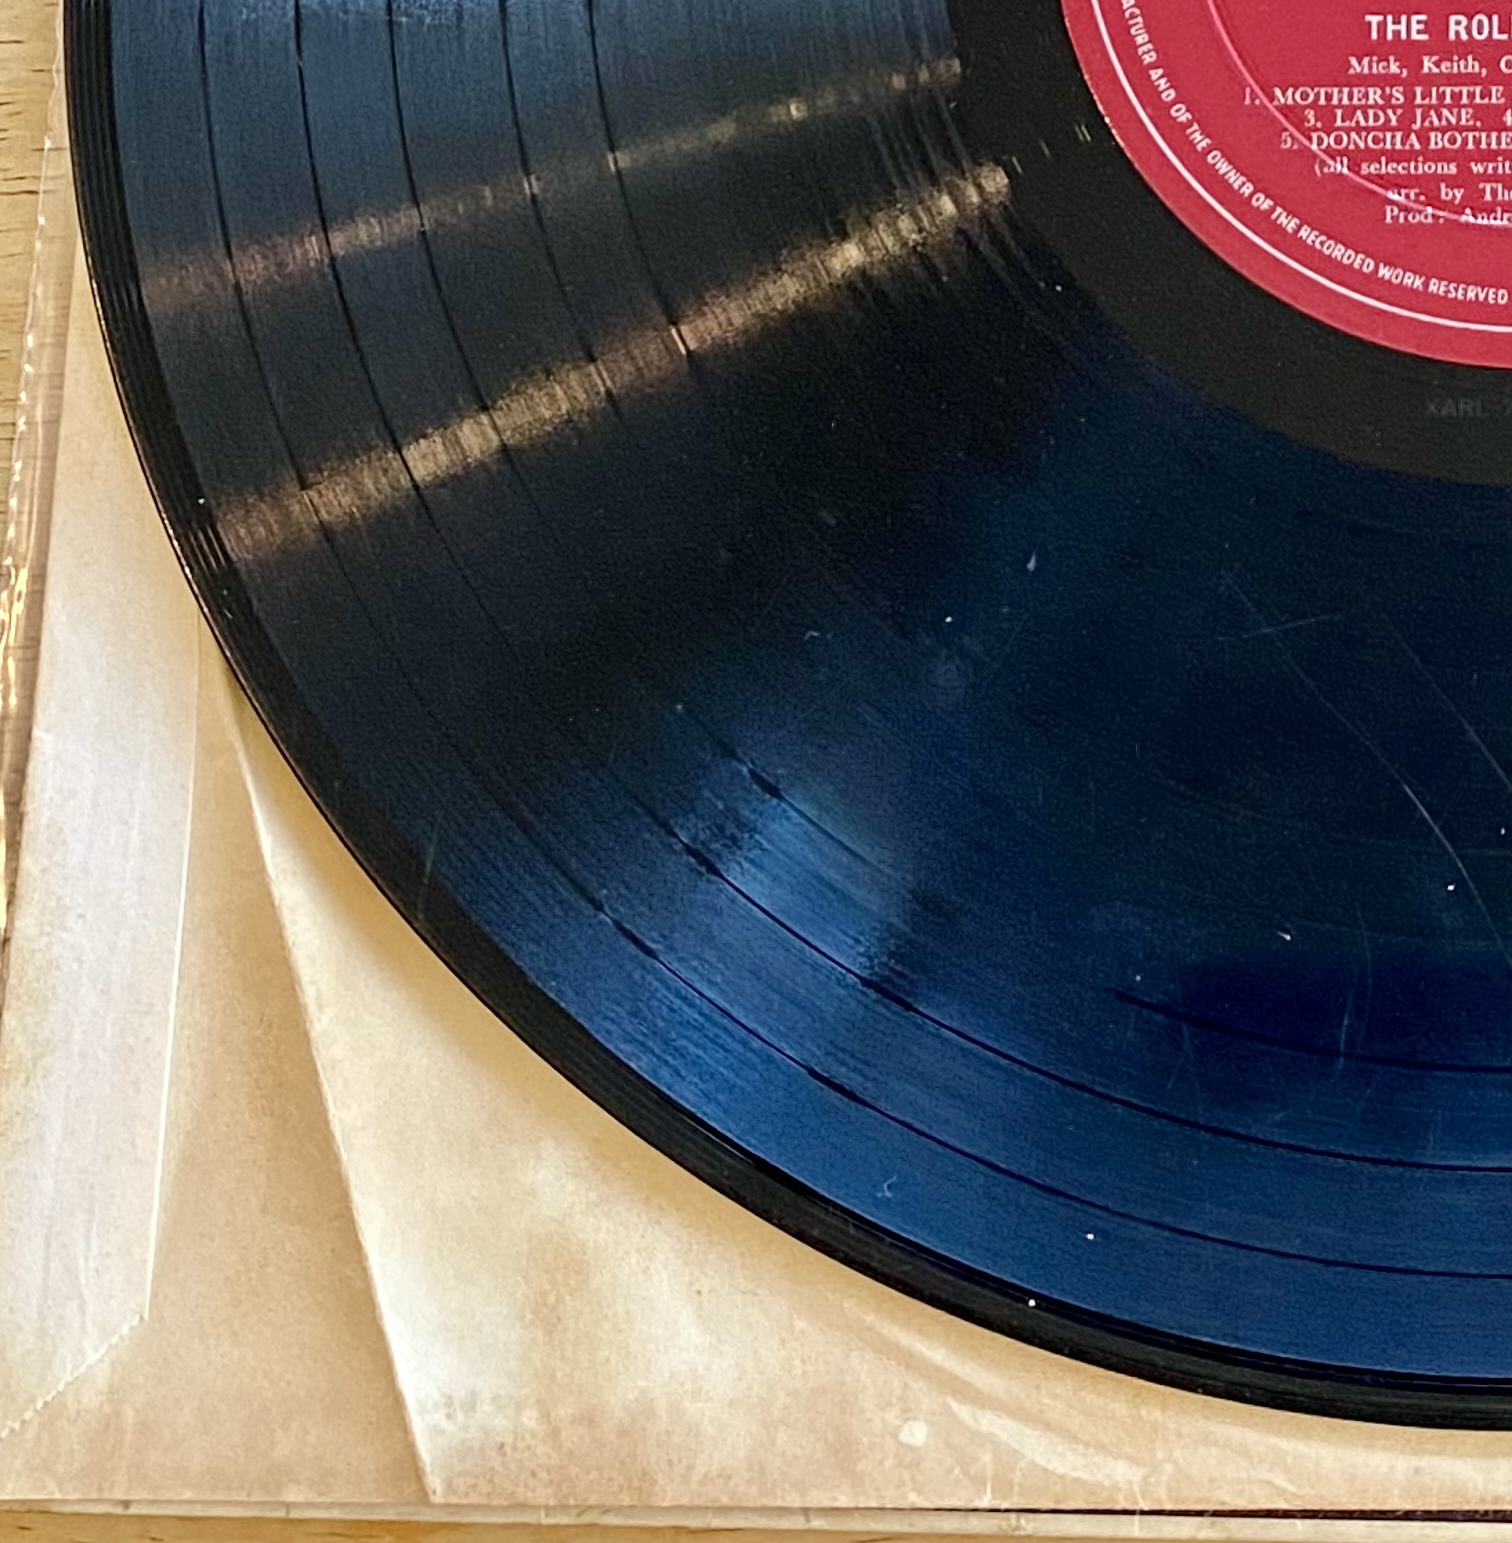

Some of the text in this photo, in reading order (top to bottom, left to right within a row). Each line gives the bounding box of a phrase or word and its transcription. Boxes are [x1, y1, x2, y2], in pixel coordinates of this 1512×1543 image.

[1364, 14, 1429, 40] THE
[1348, 56, 1408, 77] Mick,
[1421, 55, 1487, 77] Keith,
[1244, 87, 1260, 106] 1.
[1273, 86, 1404, 105] MOTHER'S
[1414, 86, 1504, 105] LITTLE
[1304, 109, 1322, 128] 3.
[1334, 108, 1403, 126] LADY
[1411, 108, 1481, 130] JANE.
[1280, 131, 1298, 149] 5.
[1310, 131, 1421, 150] DONCHA
[1315, 156, 1349, 176] (all
[1361, 156, 1457, 175] selections
[1148, 68, 1176, 102] AND
[1169, 103, 1192, 123] OF
[1185, 122, 1212, 152] THE
[1206, 150, 1254, 198] OWNER
[1251, 192, 1274, 211] OF
[1270, 206, 1300, 234] THE
[1297, 225, 1375, 273] RECORDED
[1377, 262, 1426, 290] WORK
[1428, 278, 1508, 305] RESERVED
[1386, 186, 1426, 201] arr.
[1440, 183, 1463, 205] by
